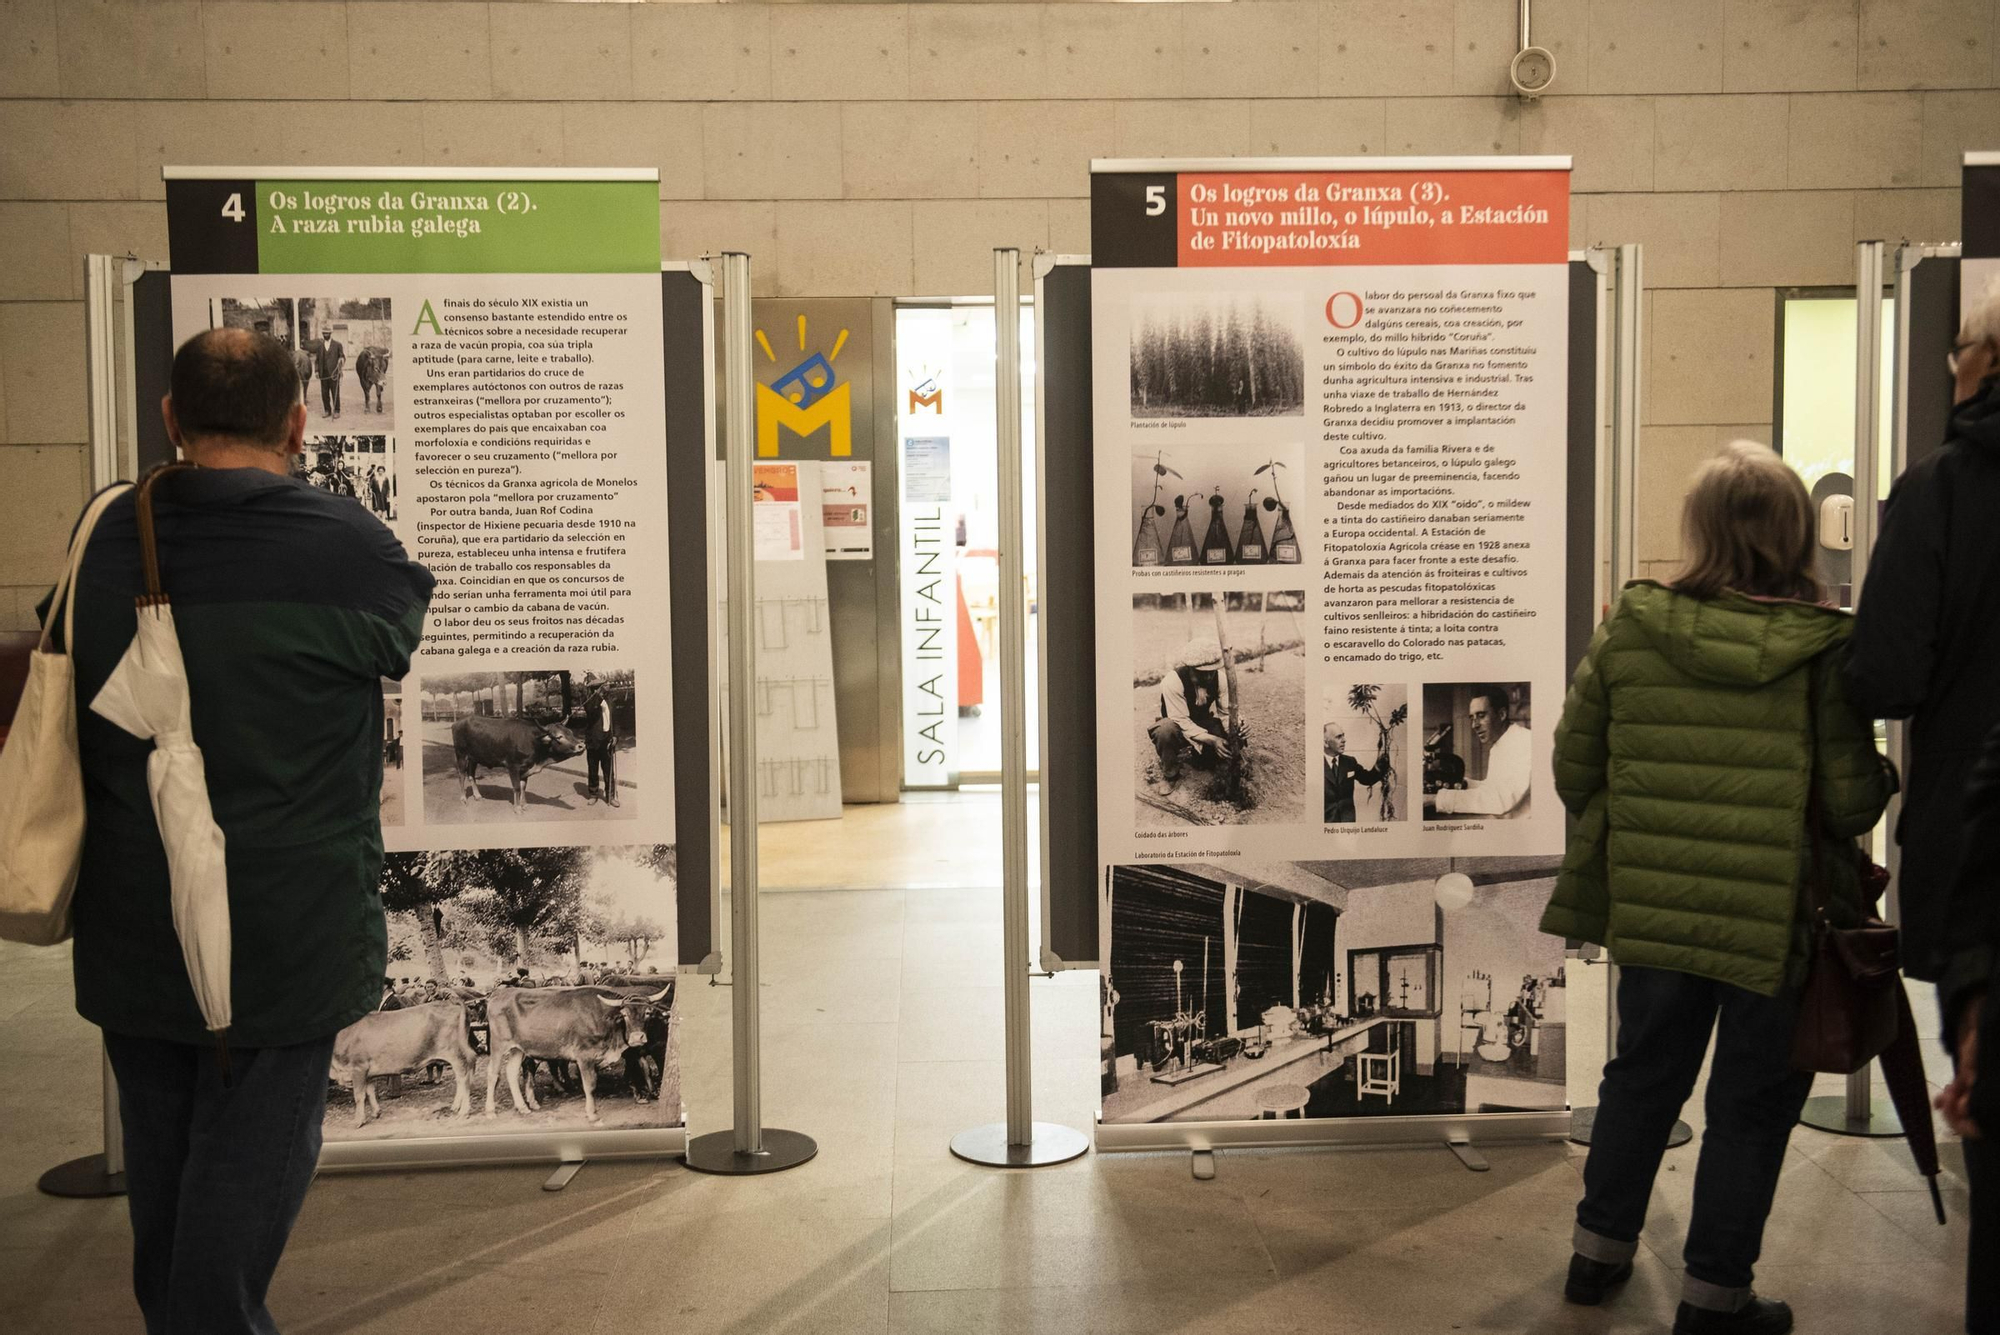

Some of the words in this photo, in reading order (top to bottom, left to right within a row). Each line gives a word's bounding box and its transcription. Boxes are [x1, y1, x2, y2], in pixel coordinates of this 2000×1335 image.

[270, 192, 297, 209] Os
[304, 192, 371, 214] logros
[378, 192, 404, 210] da
[411, 192, 489, 210] Granxa
[497, 192, 537, 214] (2).
[1146, 186, 1166, 216] 5
[1190, 184, 1217, 202] Os
[1224, 184, 1288, 207] logros
[1294, 183, 1320, 201] da
[1326, 183, 1402, 201] Granxa
[1410, 182, 1449, 204] (3).
[222, 193, 246, 222] 4
[1191, 208, 1218, 226] Un
[1226, 212, 1274, 226] novo
[1281, 206, 1338, 228] millo,
[1344, 212, 1357, 224] o
[1364, 206, 1434, 229] lúpulo,
[1441, 210, 1453, 224] a
[1461, 205, 1548, 224] Estación
[271, 215, 286, 232] A
[293, 220, 340, 233] raza
[347, 215, 404, 233] rubia
[411, 215, 481, 238] galega
[1191, 231, 1214, 250] de
[1222, 230, 1360, 254] Fitopatoloxía
[410, 298, 444, 335] A
[444, 298, 470, 307] finais
[473, 298, 486, 308] do
[488, 298, 519, 307] século
[522, 299, 538, 307] XIX
[492, 312, 534, 321] bastante
[537, 312, 586, 321] estendido
[1325, 291, 1364, 329] O
[1365, 291, 1390, 300] labor
[1392, 291, 1405, 300] do
[1408, 290, 1443, 301] persoal
[1446, 290, 1457, 299] da
[1460, 290, 1494, 299] Granxa
[1497, 290, 1515, 298] fixo
[1518, 292, 1536, 300] que
[486, 326, 513, 335] sobre
[524, 326, 578, 335] necesidade
[582, 328, 627, 337] recuperar
[444, 340, 457, 349] de
[491, 342, 525, 351] propia,
[567, 340, 593, 351] tripla
[770, 351, 836, 410] B
[908, 388, 942, 415] M
[758, 381, 852, 457] M
[1324, 460, 1379, 471] agricultores
[1382, 459, 1439, 468] betanceiros,
[1451, 458, 1482, 468] lúpulo
[1484, 458, 1516, 469] galego
[430, 480, 443, 488] Os
[488, 479, 500, 488] da
[503, 480, 537, 488] Granxa
[581, 478, 593, 486] de
[596, 478, 638, 486] Monelos
[416, 495, 466, 505] apostaron
[469, 493, 490, 504] pola
[493, 493, 534, 502] “mellora
[537, 495, 554, 503] por
[556, 492, 618, 501] cruzamento”
[430, 508, 447, 516] Por
[479, 506, 512, 516] banda,
[515, 507, 537, 515] Juan
[540, 506, 556, 514] Rof
[559, 505, 593, 514] Codina
[416, 522, 466, 532] (inspector
[468, 521, 481, 530] de
[484, 521, 520, 529] Hixiene
[523, 522, 564, 531] pecuaria
[566, 519, 596, 528] desde
[599, 519, 622, 528] 1910
[1332, 530, 1365, 539] Europa
[1368, 528, 1418, 537] occidental.
[1421, 528, 1428, 536] A
[1432, 528, 1471, 536] Estación
[1474, 527, 1486, 536] de
[914, 506, 944, 660] INFANTIL
[1324, 584, 1336, 594] de
[1338, 584, 1364, 593] horta
[1380, 583, 1422, 594] pescudas
[1425, 582, 1496, 593] fitopatolóxicas
[1376, 600, 1397, 608] para
[1400, 597, 1439, 606] mellorar
[1502, 596, 1514, 604] de
[420, 646, 455, 655] cabana
[458, 645, 491, 657] galega
[553, 644, 565, 652] da
[592, 643, 619, 652] rubia.
[1333, 652, 1382, 661] encamado
[1384, 652, 1397, 661] do
[1399, 653, 1424, 663] trigo,
[917, 673, 945, 764] SALA
